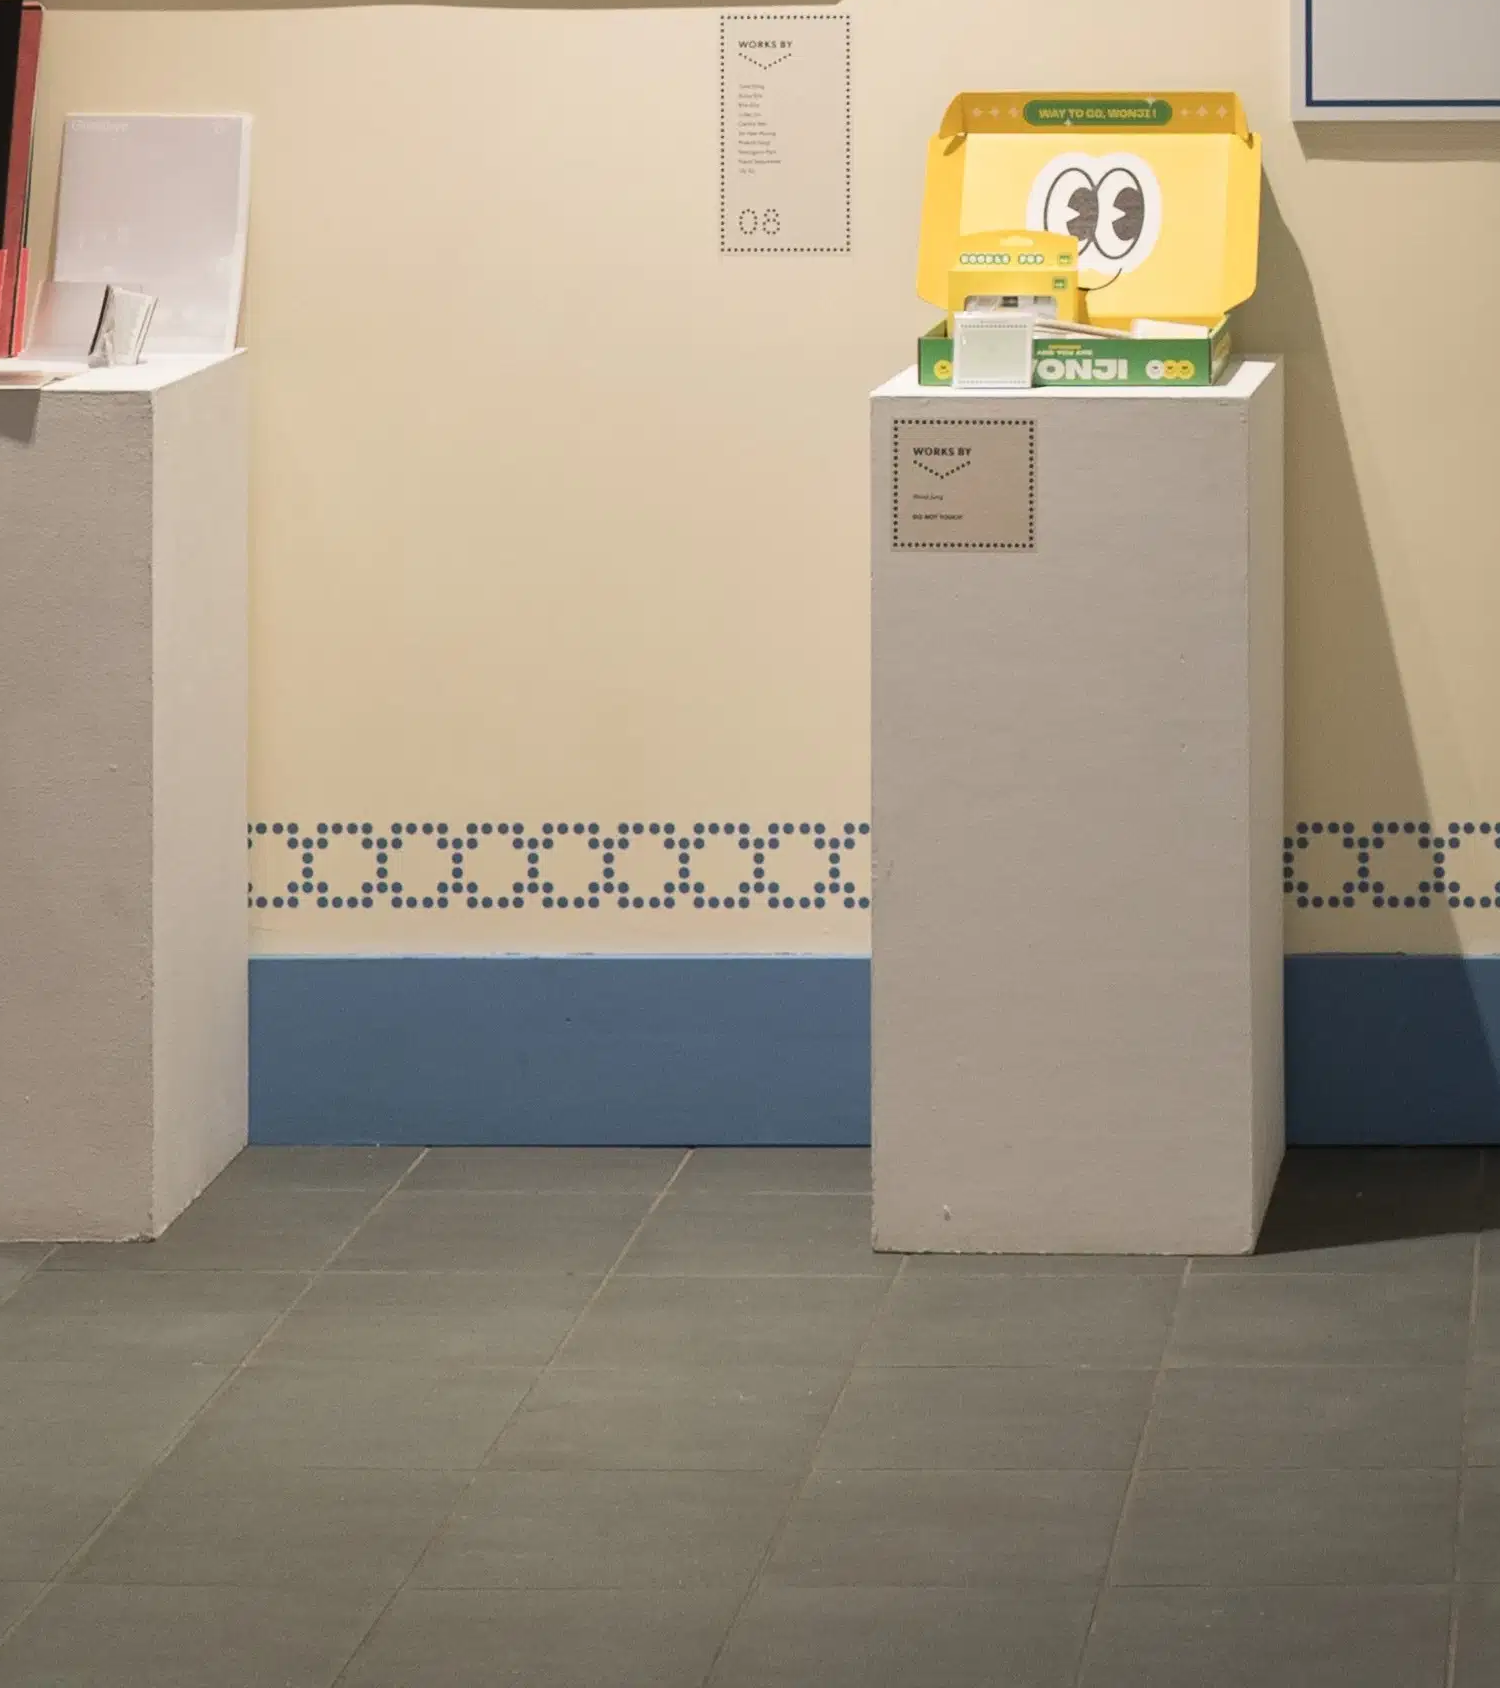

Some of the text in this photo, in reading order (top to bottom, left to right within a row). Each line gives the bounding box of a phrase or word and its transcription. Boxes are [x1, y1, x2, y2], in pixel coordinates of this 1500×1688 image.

[738, 40, 793, 49] WORKS BY
[739, 208, 781, 236] 08
[1034, 358, 1129, 381] ONJI
[913, 447, 972, 456] WORKS BY
